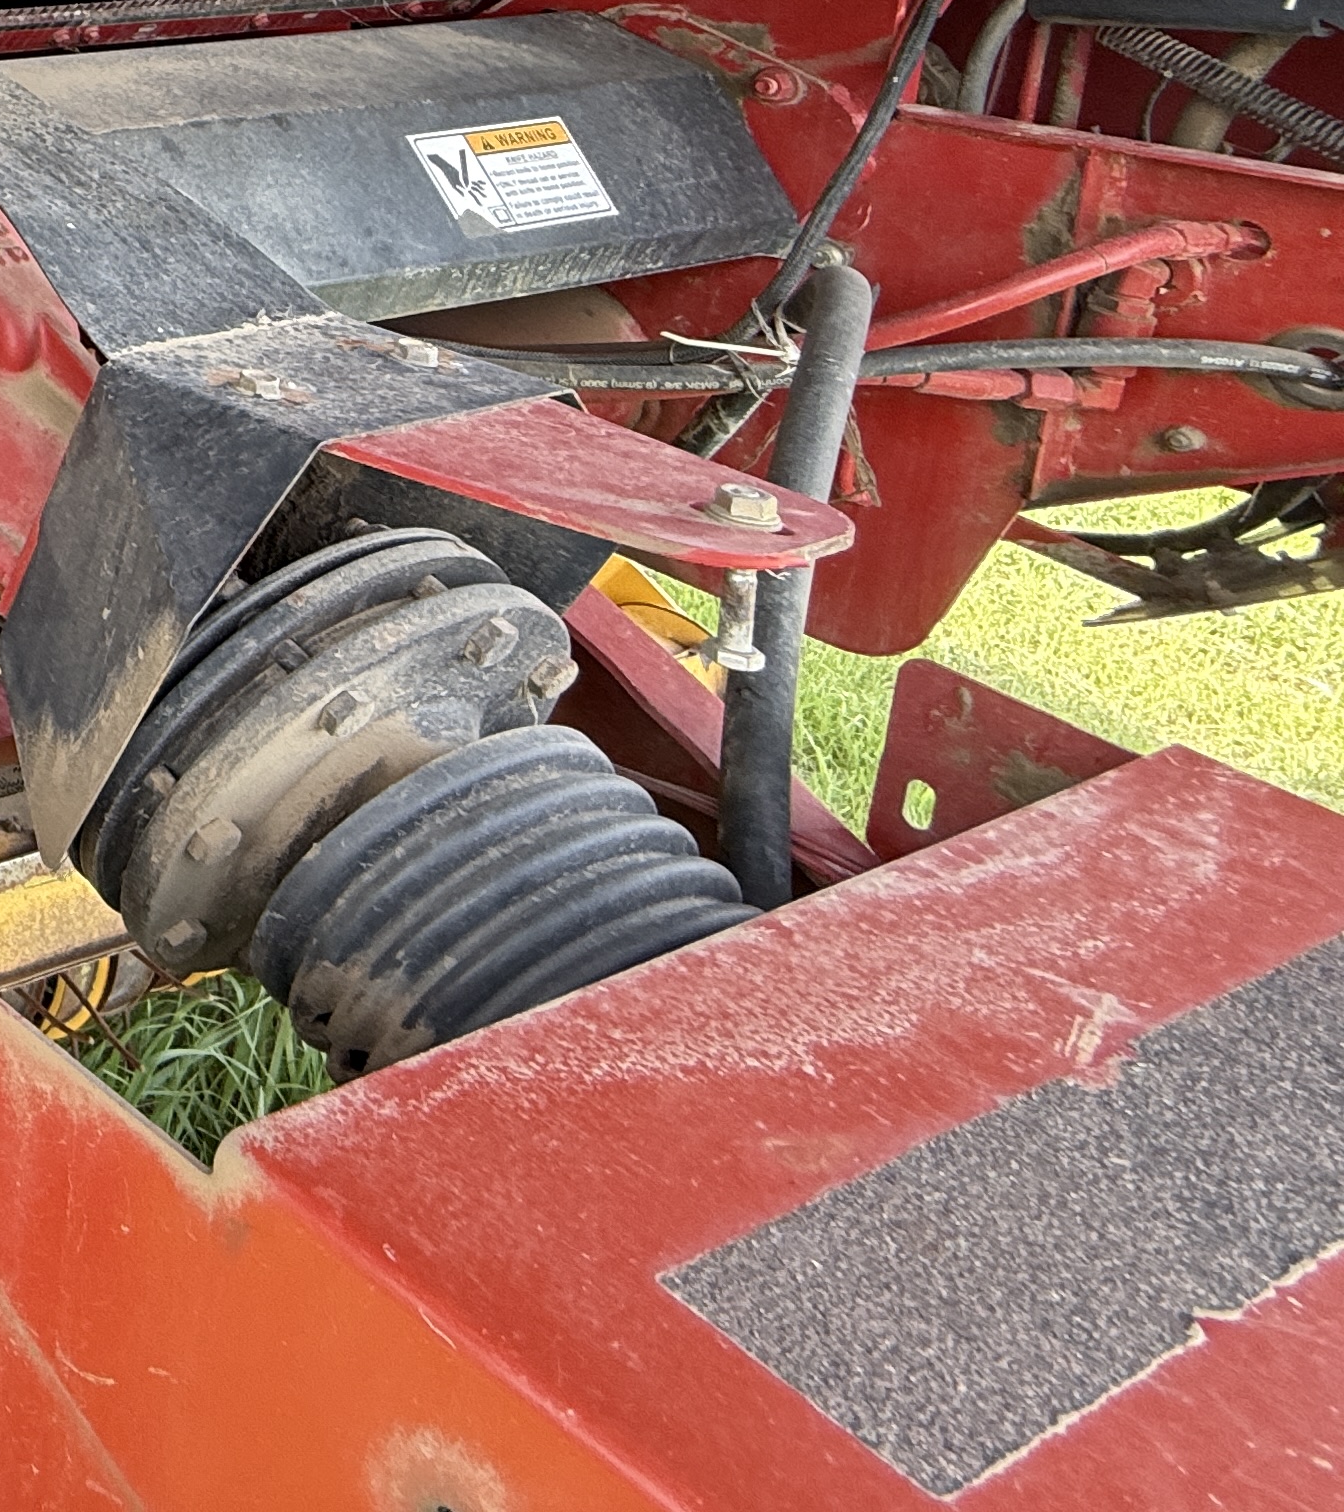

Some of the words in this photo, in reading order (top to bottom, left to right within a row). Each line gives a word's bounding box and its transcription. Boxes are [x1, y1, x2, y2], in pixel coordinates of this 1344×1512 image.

[495, 127, 557, 147] WARNING
[528, 150, 559, 162] HAZARD
[580, 379, 609, 389] 3000
